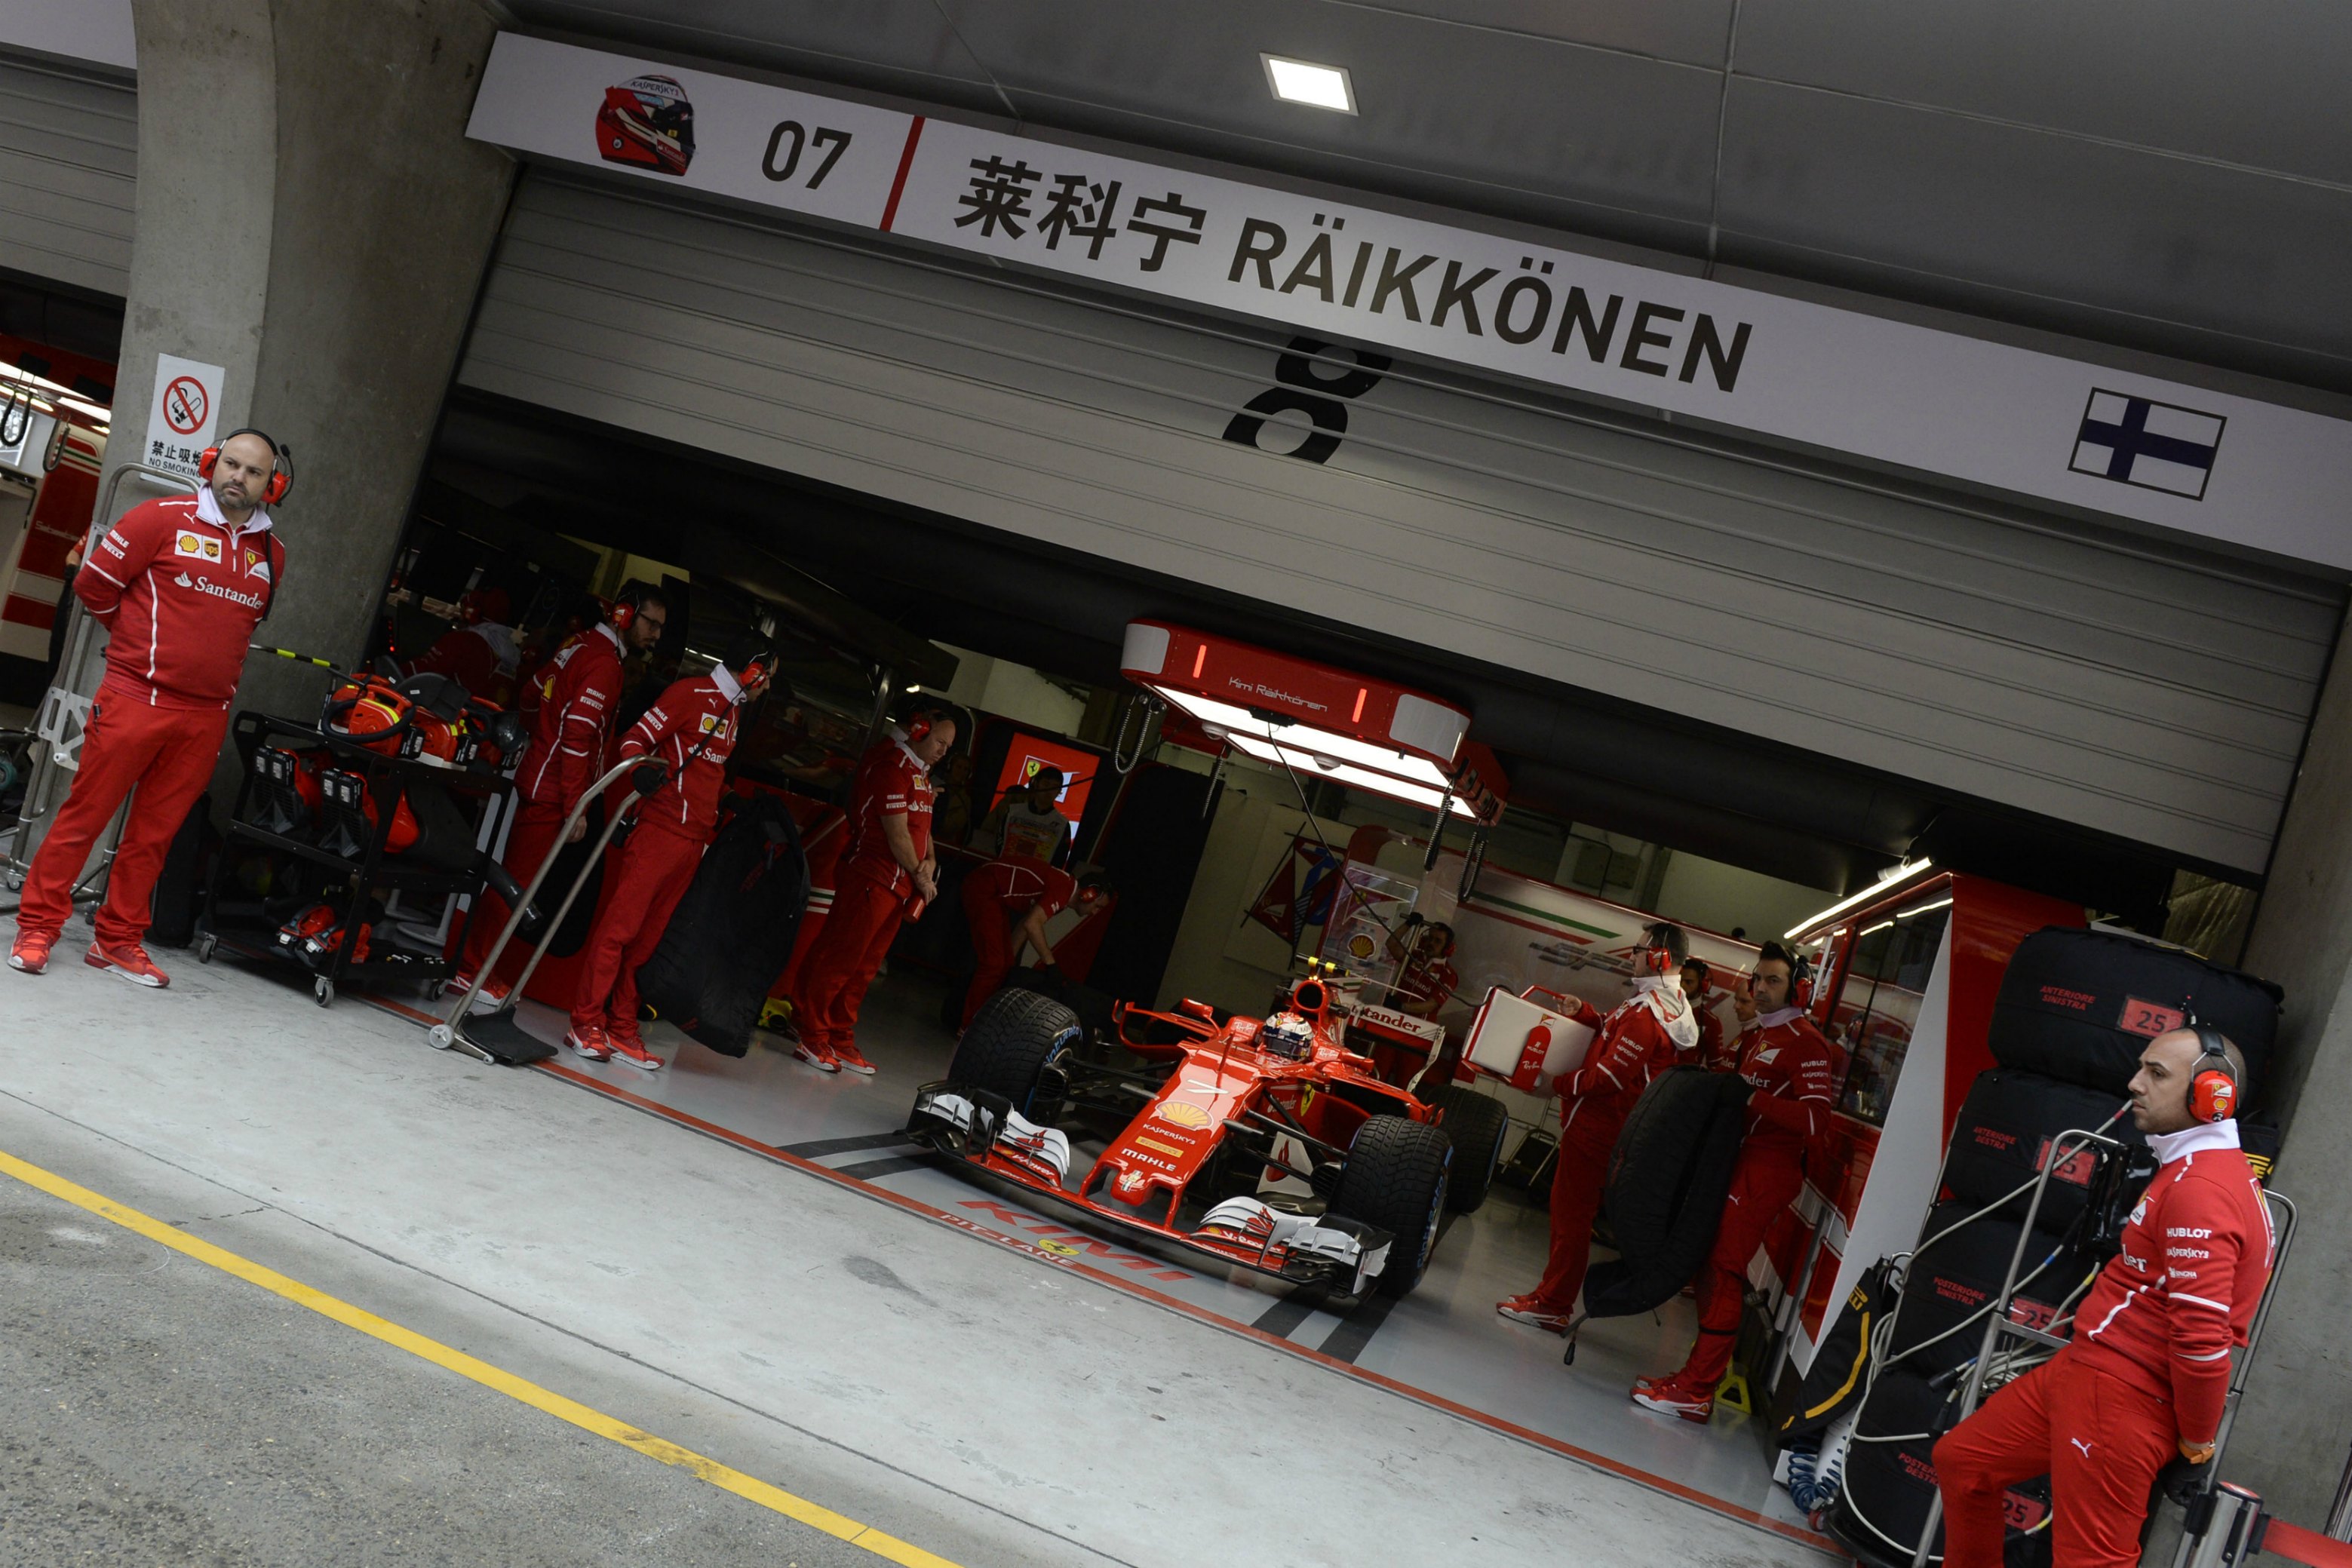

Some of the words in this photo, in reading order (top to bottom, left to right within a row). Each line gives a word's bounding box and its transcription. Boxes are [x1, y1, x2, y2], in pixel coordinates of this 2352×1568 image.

[761, 120, 853, 190] 07
[953, 155, 1208, 272] 莱科宁
[1227, 213, 1754, 394] RÄIKKÖNEN
[149, 457, 161, 467] NO
[204, 545, 220, 557] ups
[1229, 677, 1254, 692] Kimi
[1256, 684, 1328, 712] Räikkönen
[2040, 985, 2096, 1005] ANTERIORE
[2041, 993, 2087, 1011] SINISTRA
[1363, 1006, 1422, 1033] tander
[2136, 1010, 2167, 1033] 25
[1620, 1036, 1644, 1053] HUBLOT
[1801, 1060, 1828, 1069] HUBLOT
[1121, 1147, 1178, 1172] MAHLE
[940, 1214, 1077, 1267] PIT-LANE
[956, 1201, 1194, 1281] KIMI
[2166, 1227, 2212, 1239] HUBLOT
[1933, 1276, 1988, 1301] POSTERIORE
[1936, 1287, 1976, 1306] SINISTRA
